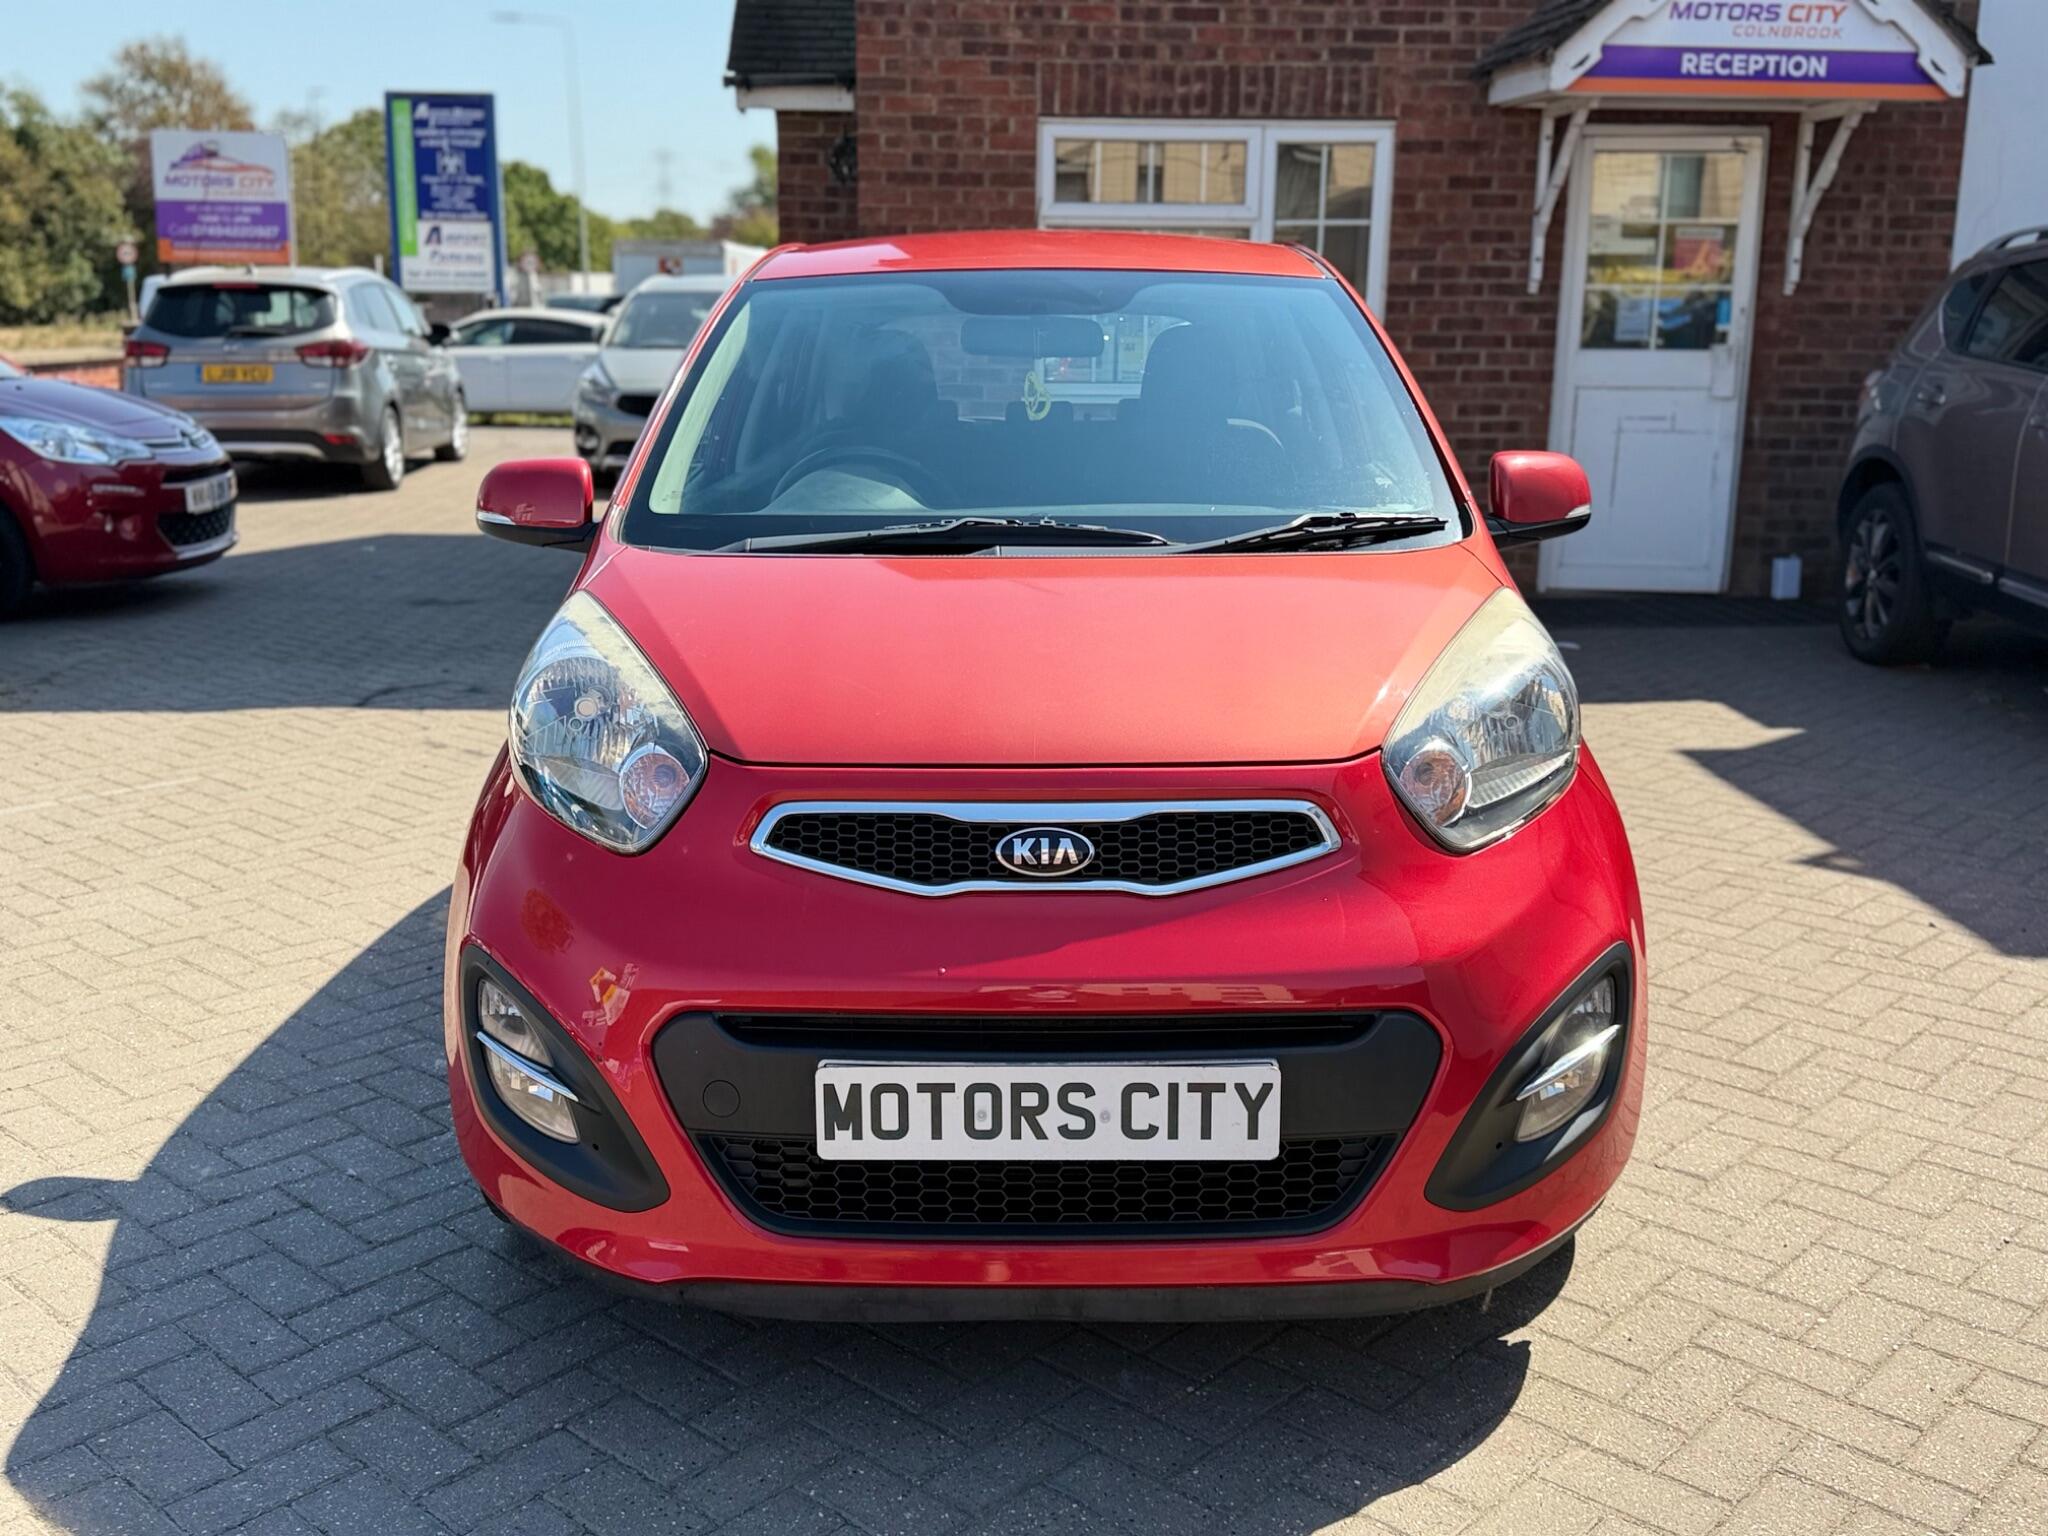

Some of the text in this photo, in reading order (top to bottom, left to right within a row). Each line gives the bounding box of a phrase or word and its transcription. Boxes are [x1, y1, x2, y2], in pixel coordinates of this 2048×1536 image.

[1669, 1, 1848, 24] MOTORS CITY
[1732, 24, 1843, 39] COLNBROOK
[1680, 52, 1828, 78] RECEPTION
[164, 174, 275, 189] MOTORS CITY
[1011, 837, 1079, 865] KIA
[823, 1082, 1274, 1142] MOTORS CITY
